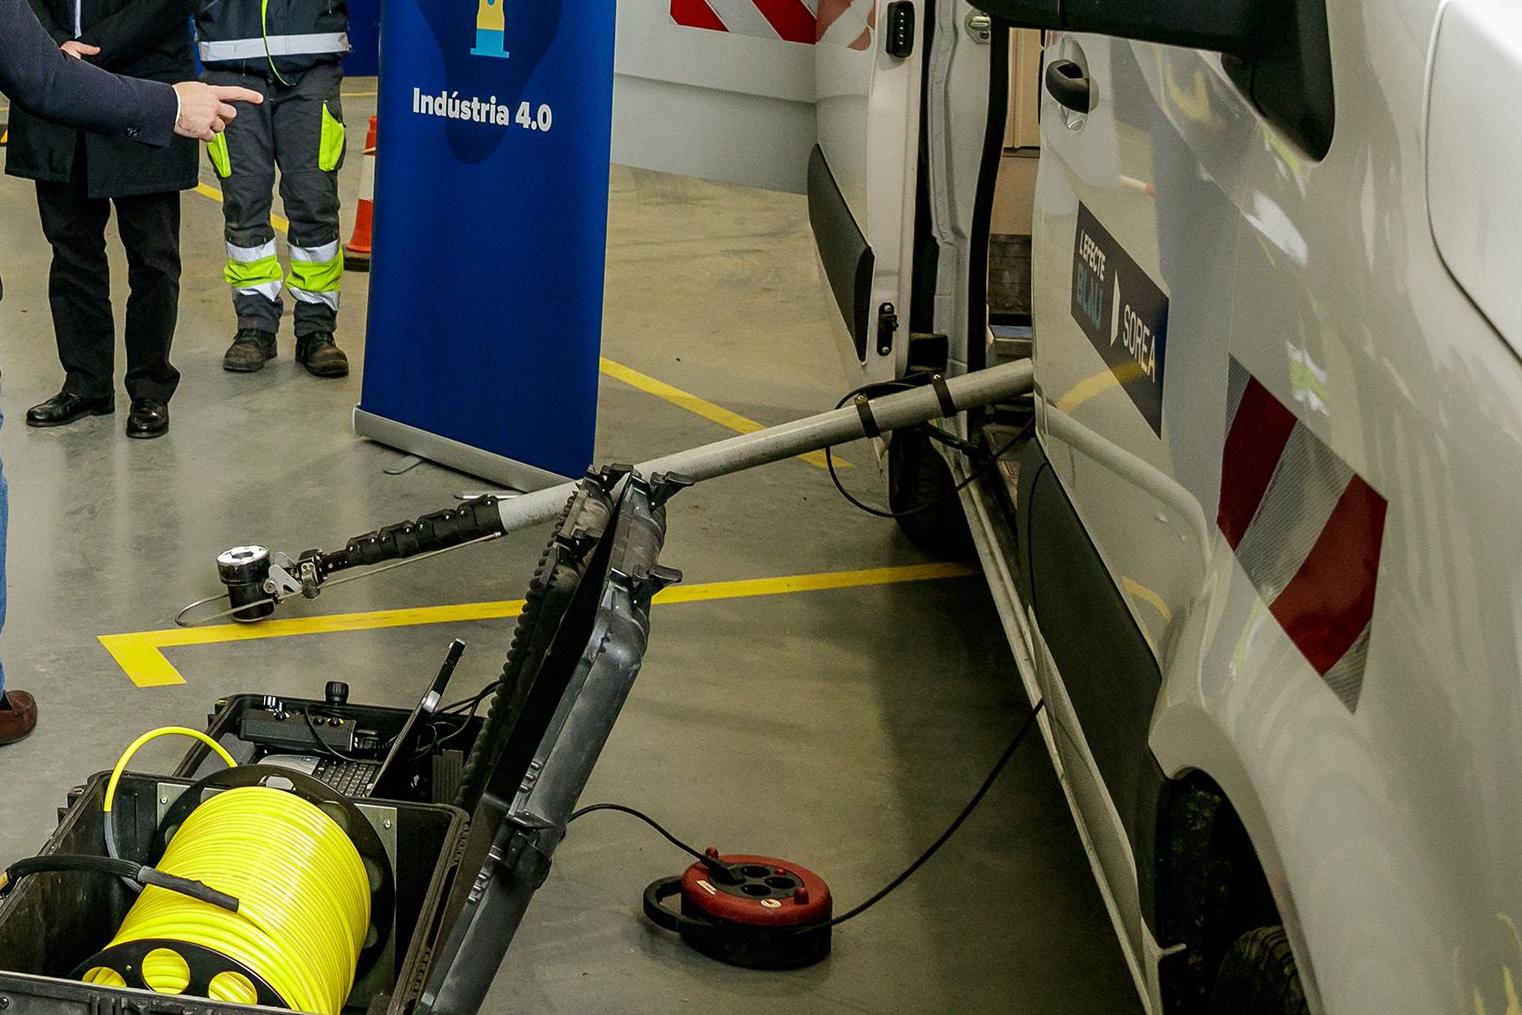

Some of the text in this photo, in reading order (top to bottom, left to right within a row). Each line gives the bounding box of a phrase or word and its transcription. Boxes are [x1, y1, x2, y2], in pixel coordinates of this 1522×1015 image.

[412, 86, 553, 133] Indústria 4.0
[1079, 229, 1106, 282] L'EFECTE
[1075, 261, 1103, 331] BLAU
[1122, 303, 1157, 384] SOREA
